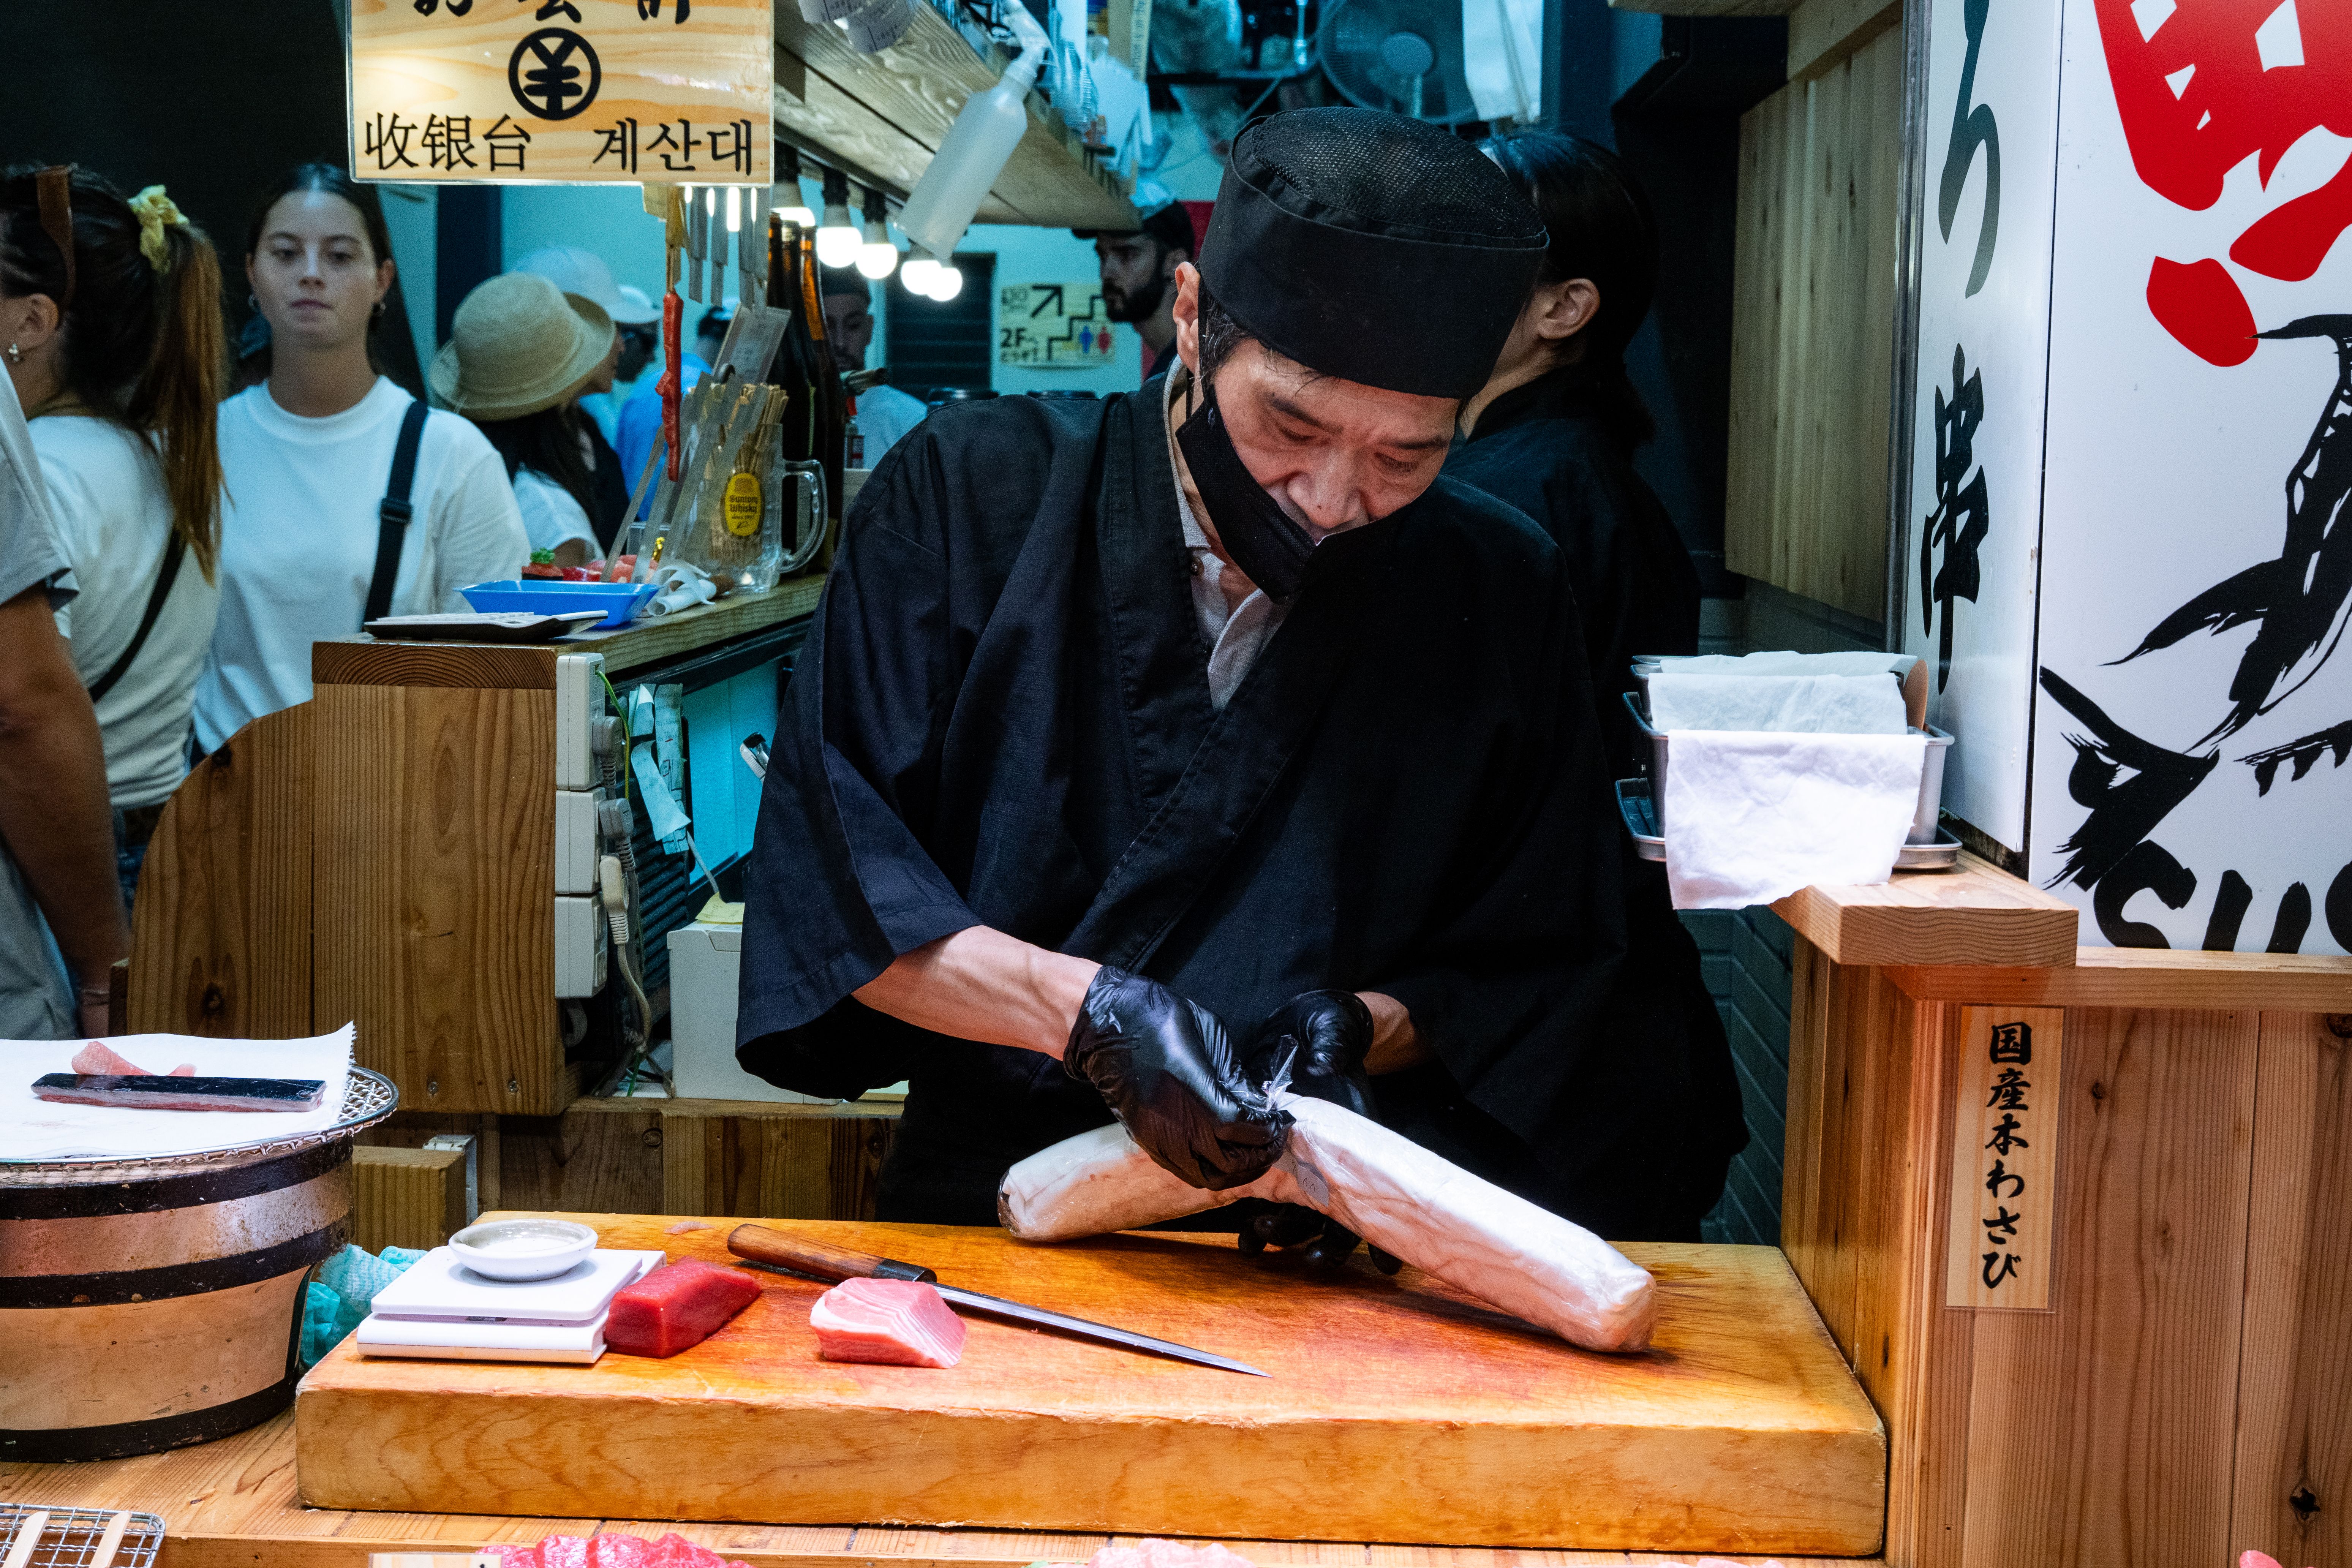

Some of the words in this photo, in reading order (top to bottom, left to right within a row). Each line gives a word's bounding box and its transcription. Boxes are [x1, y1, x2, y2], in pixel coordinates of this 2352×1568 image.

[364, 112, 532, 171] 收银台
[591, 117, 752, 176] 계산대
[729, 495, 758, 504] Suntory
[729, 504, 757, 514] Whisky
[1982, 1021, 2032, 1289] 国産本わさび
